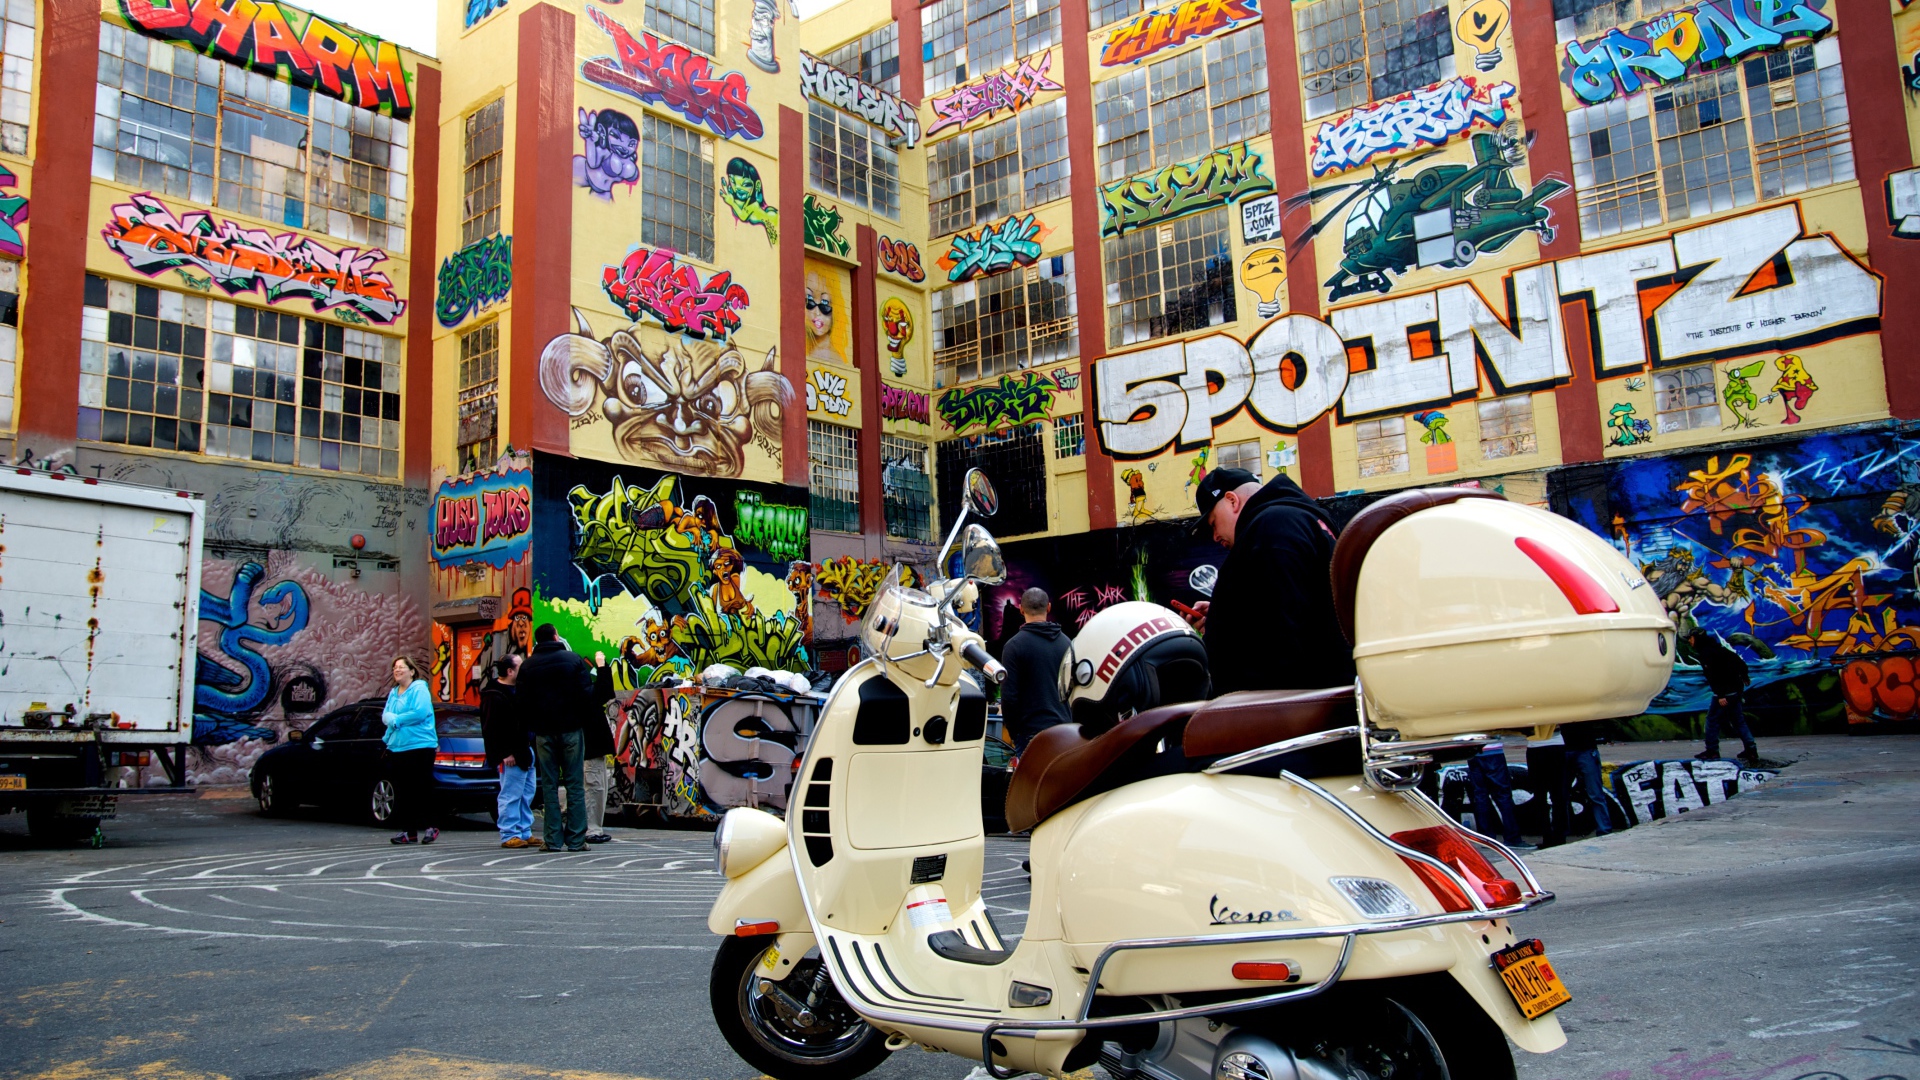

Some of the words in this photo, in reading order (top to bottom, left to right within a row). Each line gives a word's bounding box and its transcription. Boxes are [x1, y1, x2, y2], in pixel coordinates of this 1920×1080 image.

[1301, 37, 1364, 75] LOOK
[1245, 200, 1275, 219] 5PTZ
[1249, 215, 1275, 232] .COM
[1091, 202, 1883, 462] 5POINTZ
[1746, 321, 1756, 330] OF
[813, 370, 847, 398] NYC
[437, 497, 479, 552] HUSH
[482, 487, 531, 546] TOURS
[738, 504, 807, 543] DEADLY
[1060, 585, 1091, 611] THE
[1093, 583, 1128, 607] DARK
[1622, 758, 1743, 825] FAT
[1209, 893, 1303, 926] Vespa
[1516, 945, 1535, 958] YORK
[1531, 997, 1551, 1013] EMPIRE
[1547, 992, 1563, 1005] STATE
